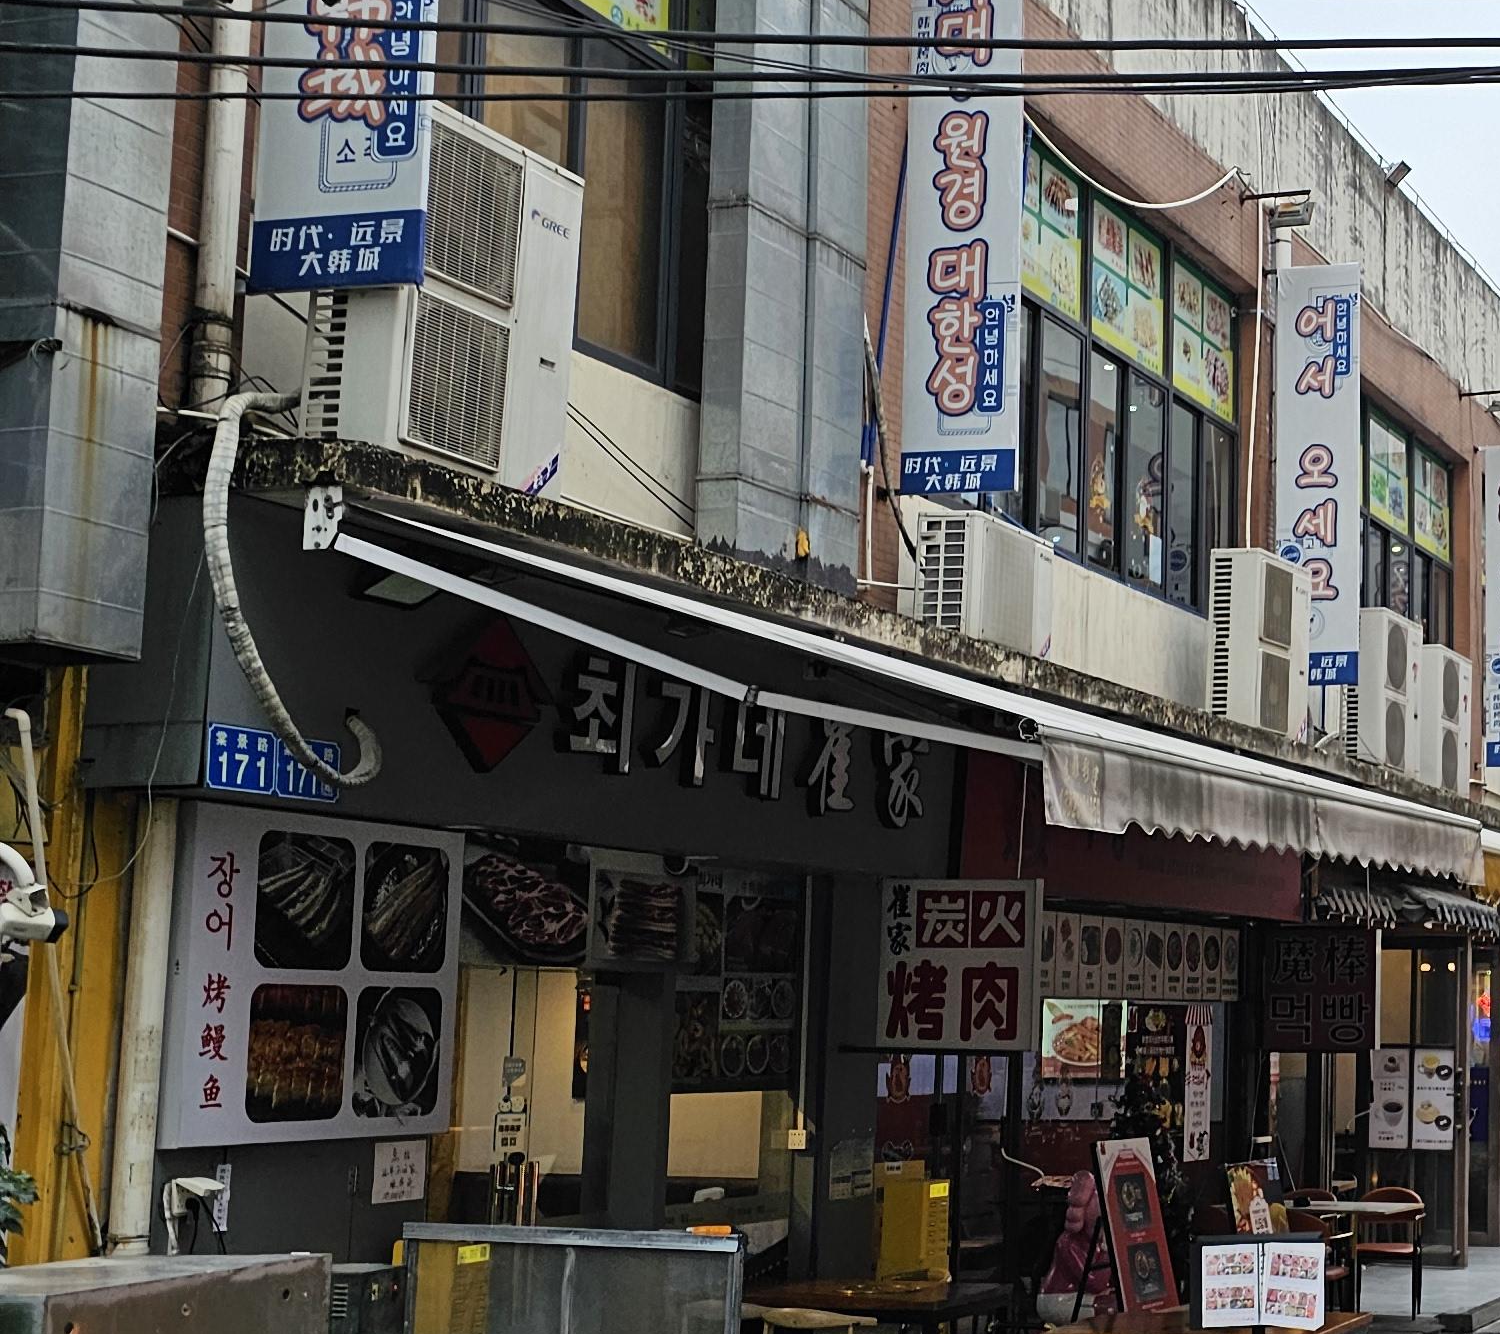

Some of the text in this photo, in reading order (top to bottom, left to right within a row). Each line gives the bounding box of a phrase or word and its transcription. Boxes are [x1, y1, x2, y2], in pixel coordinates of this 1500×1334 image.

[933, 110, 990, 233] 원경
[298, 247, 382, 277] 大韩城
[541, 217, 571, 240] GREE
[926, 238, 990, 417] 대한성
[983, 307, 1001, 408] 안녕하세요
[1295, 298, 1337, 398] 어서
[1335, 302, 1348, 374] 안녕하세요
[924, 472, 982, 492] 大韩城
[1293, 443, 1340, 601] 오세요
[569, 655, 787, 800] 최가네
[218, 751, 266, 788] 171
[921, 894, 1023, 945] 炭火
[198, 850, 241, 1110] 장어 烤鳗鱼
[1271, 935, 1369, 985] 魔棒
[885, 958, 1020, 1042] 烤肉
[1270, 992, 1372, 1045] 먹빵
